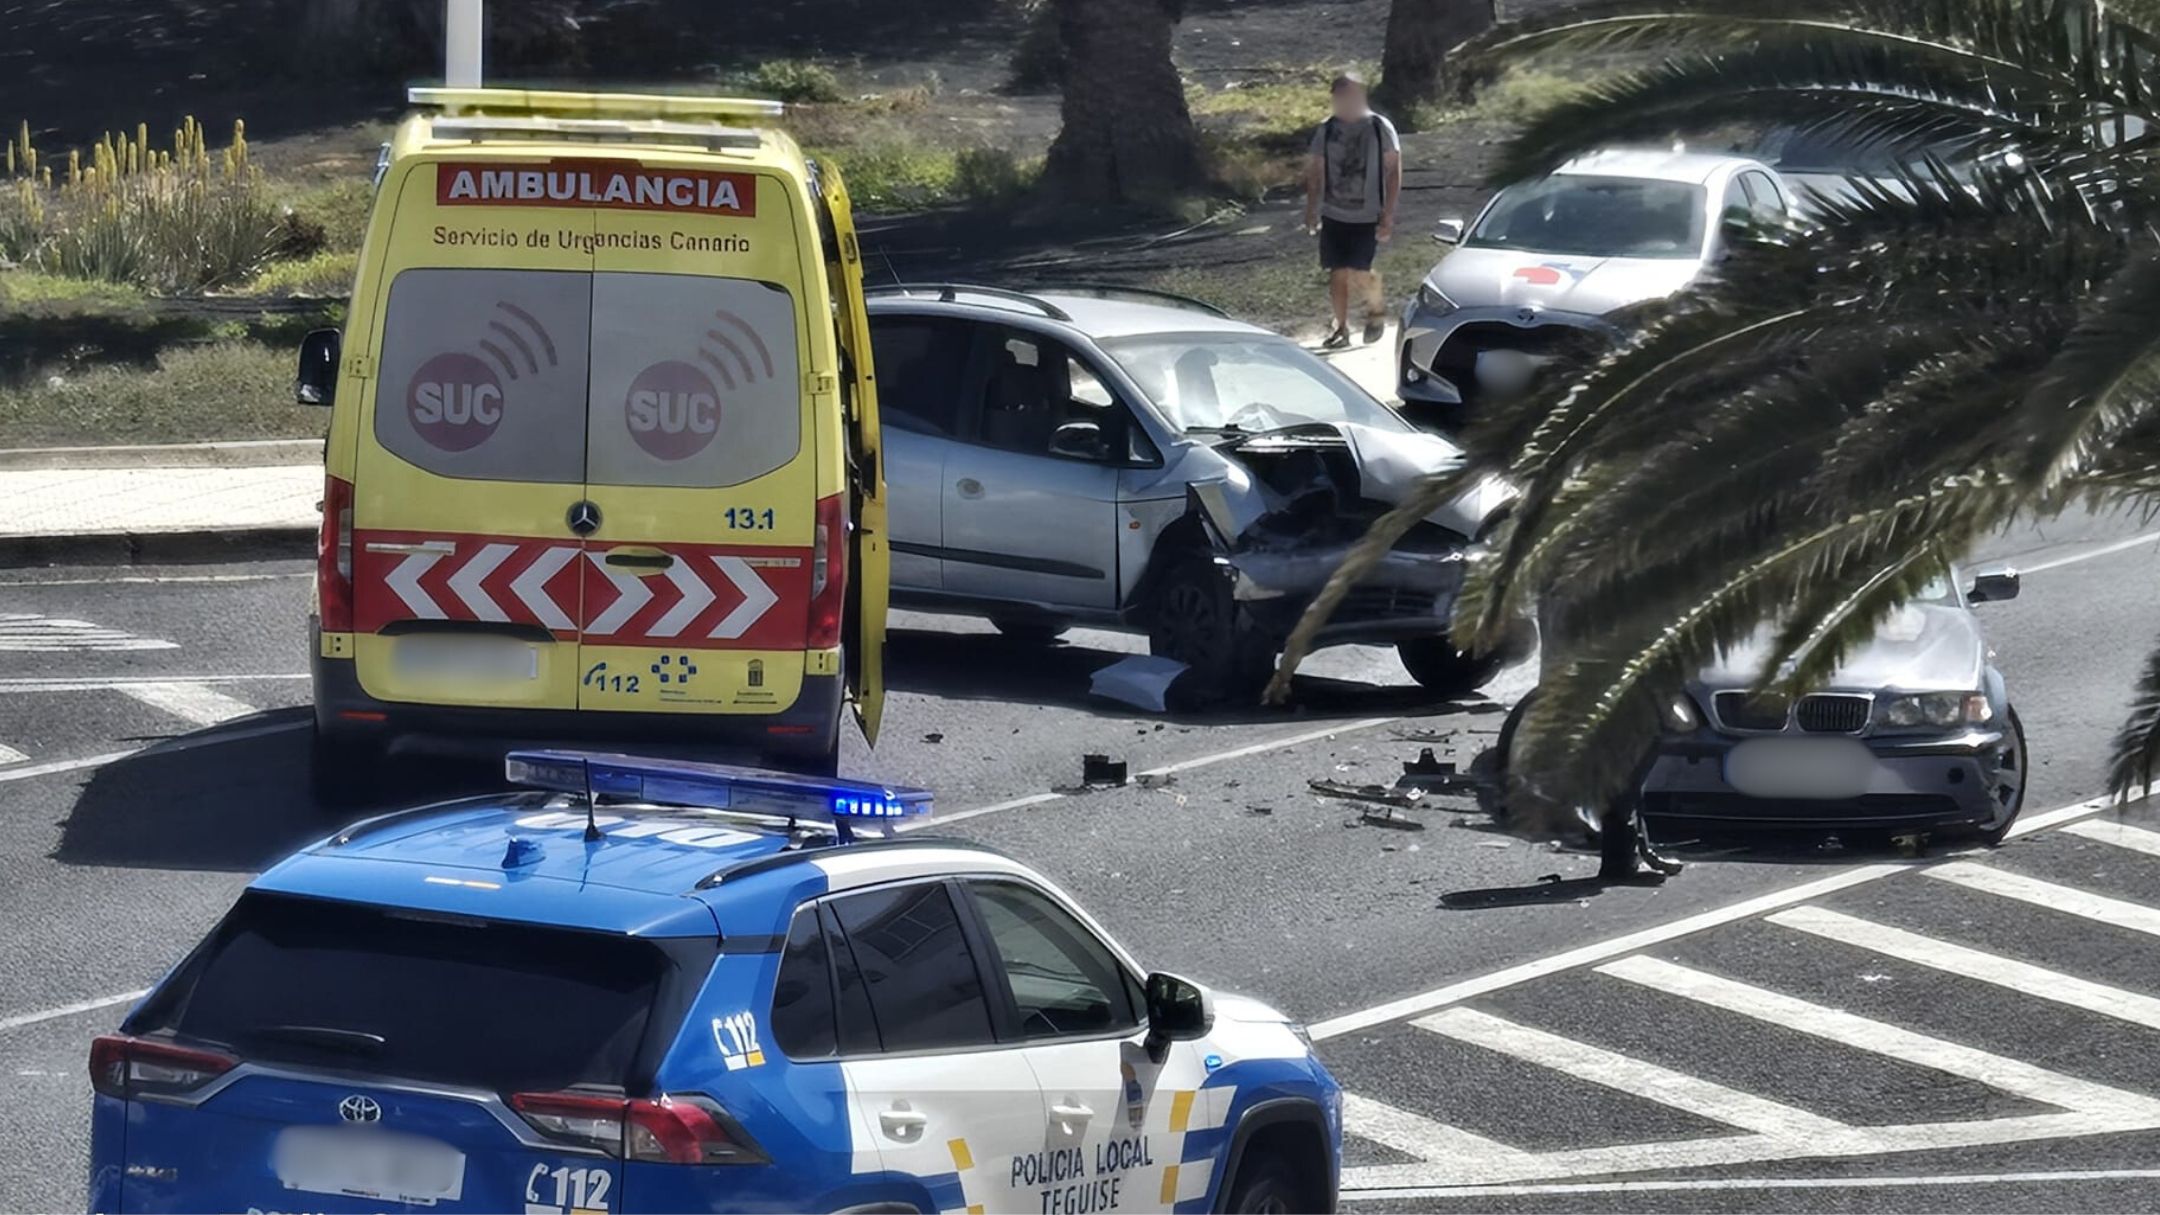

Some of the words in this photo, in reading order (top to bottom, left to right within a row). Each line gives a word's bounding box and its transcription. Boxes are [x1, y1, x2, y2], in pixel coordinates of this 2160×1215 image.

[448, 169, 741, 211] AMBULANCIA
[433, 226, 518, 247] Servicio
[526, 229, 550, 248] de
[558, 229, 662, 255] Urgencias
[670, 231, 750, 252] Canario
[414, 381, 501, 426] SUC
[629, 390, 715, 434] SUC
[724, 507, 774, 530] 13.1
[596, 674, 640, 694] 112
[724, 1010, 761, 1055] 112
[1011, 1147, 1085, 1188] POLICIA
[1096, 1135, 1154, 1176] LOCAL
[550, 1166, 612, 1211] 112
[1040, 1177, 1121, 1215] TEGUISE
